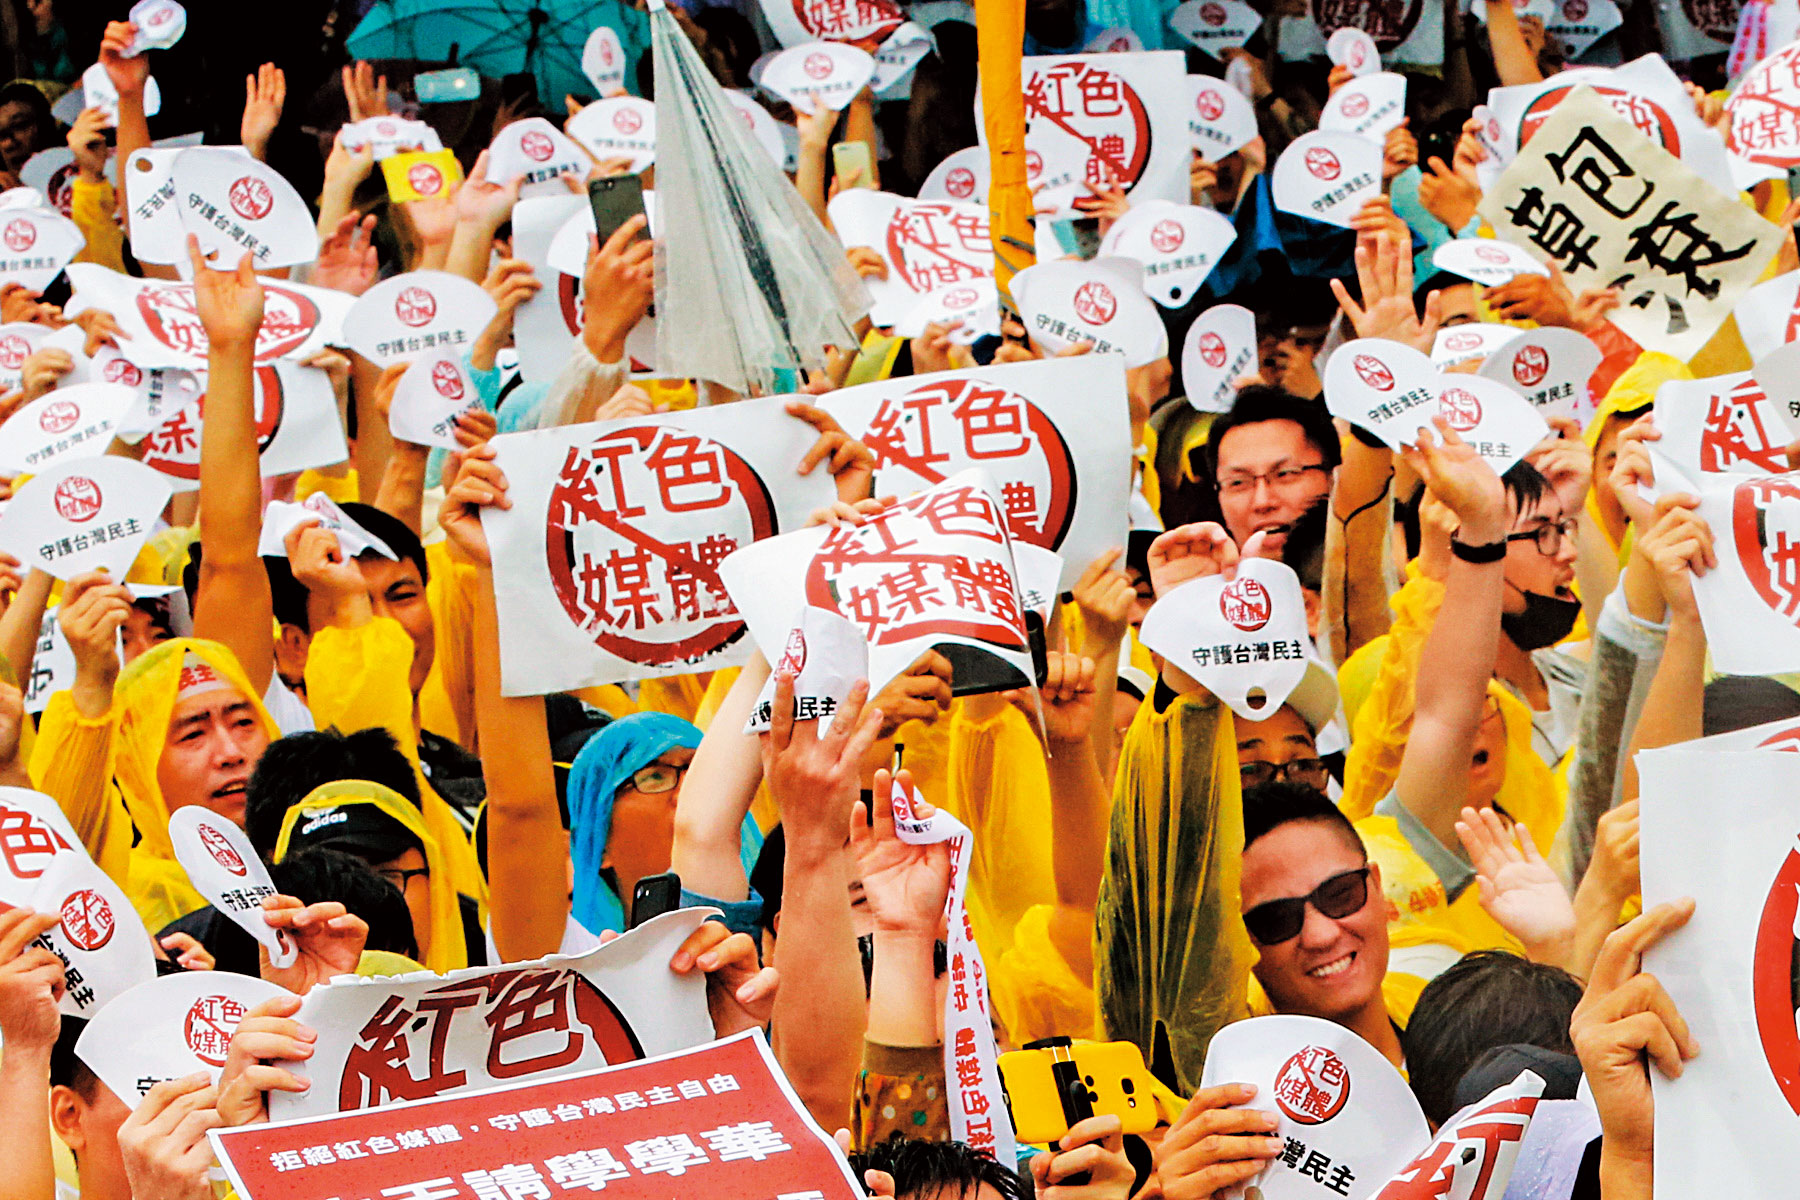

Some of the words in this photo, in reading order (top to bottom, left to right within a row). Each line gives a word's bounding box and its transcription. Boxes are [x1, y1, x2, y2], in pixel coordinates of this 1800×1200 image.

[1025, 69, 1124, 119] 紅色
[188, 192, 272, 263] 守護台灣民主
[375, 329, 468, 358] 守護台灣民主
[864, 383, 1031, 468] 紅色
[1367, 387, 1434, 423] 守護台灣民主
[26, 419, 114, 465] 守護台灣民主
[564, 427, 731, 529] 紅色
[38, 517, 143, 562] 守護台灣民主
[820, 484, 1006, 572] 紅色
[579, 530, 740, 632] 媒體
[848, 553, 1022, 640] 媒體
[1192, 640, 1304, 666] 守護台灣民主
[301, 812, 349, 835] adidas
[358, 966, 586, 1100] 紅色
[1294, 1043, 1348, 1085] 紅色
[268, 1071, 742, 1175] 拒絕紅色媒體，守護台灣民主自由
[1276, 1075, 1333, 1121] 媒體
